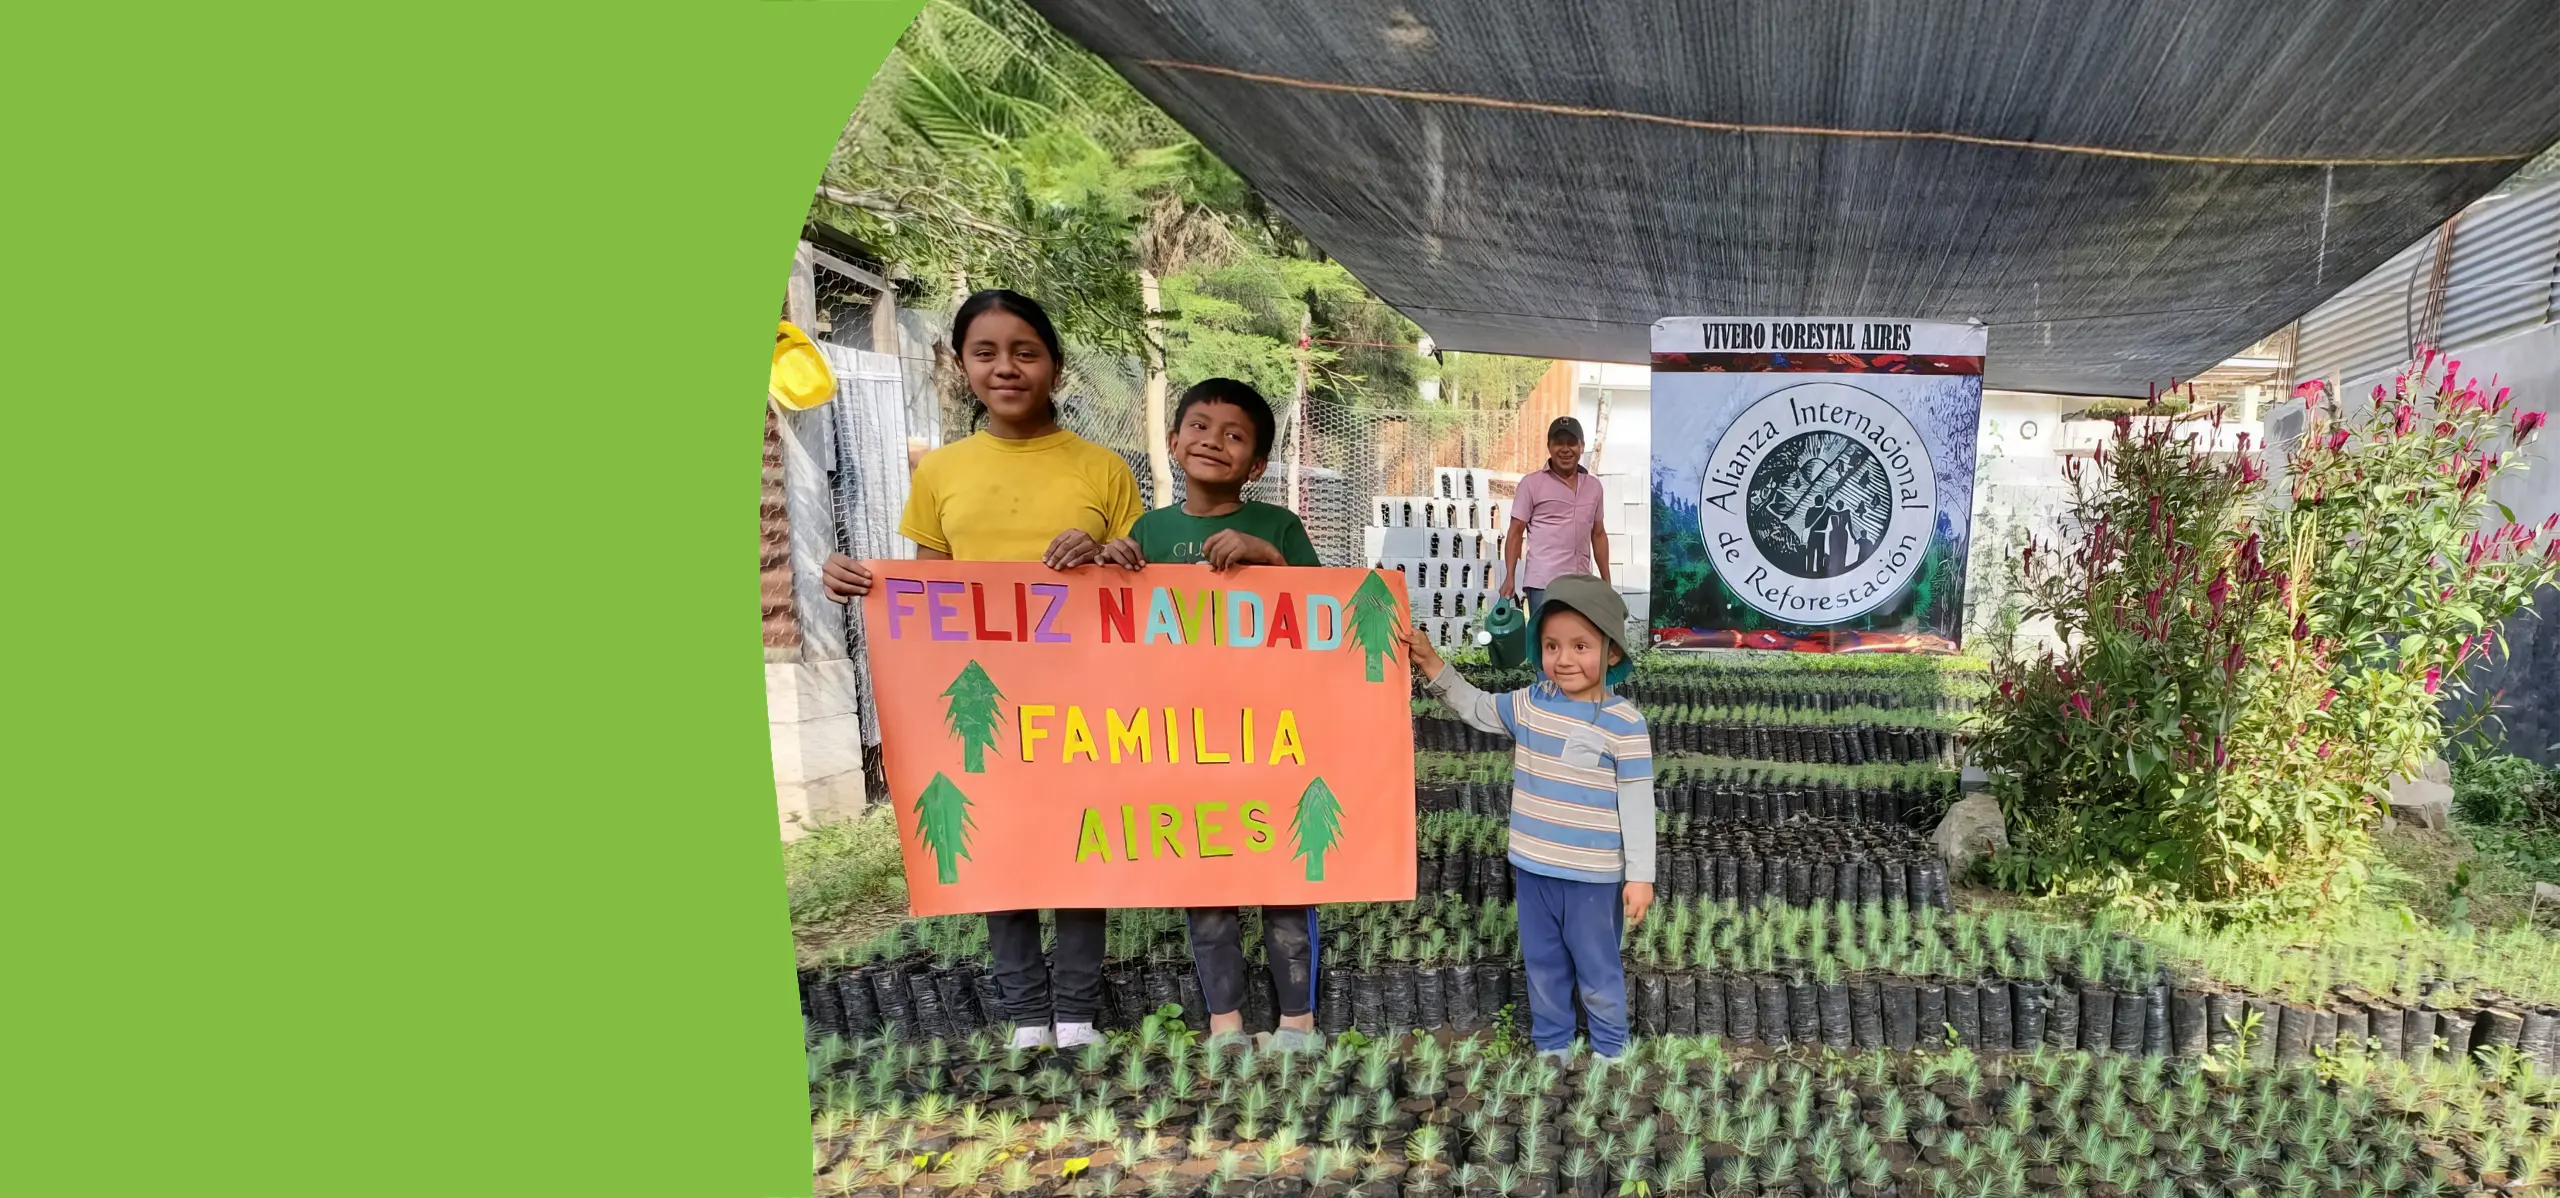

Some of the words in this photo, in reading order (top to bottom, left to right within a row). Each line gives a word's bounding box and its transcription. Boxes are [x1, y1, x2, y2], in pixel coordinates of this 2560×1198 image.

[1702, 323, 1766, 350] VIVERO
[1771, 323, 1856, 350] FORESTAL
[1861, 323, 1912, 351] AIRES
[1706, 420, 1780, 515] Alianza
[1790, 397, 1929, 511] Internacional
[1719, 532, 1743, 562] de
[1745, 535, 1917, 612] Reforestación
[886, 577, 1070, 642] FELIZ
[1101, 587, 1343, 650] NAVIDAD
[1019, 705, 1306, 766] FAMILIA
[1075, 800, 1276, 863] AIRES
